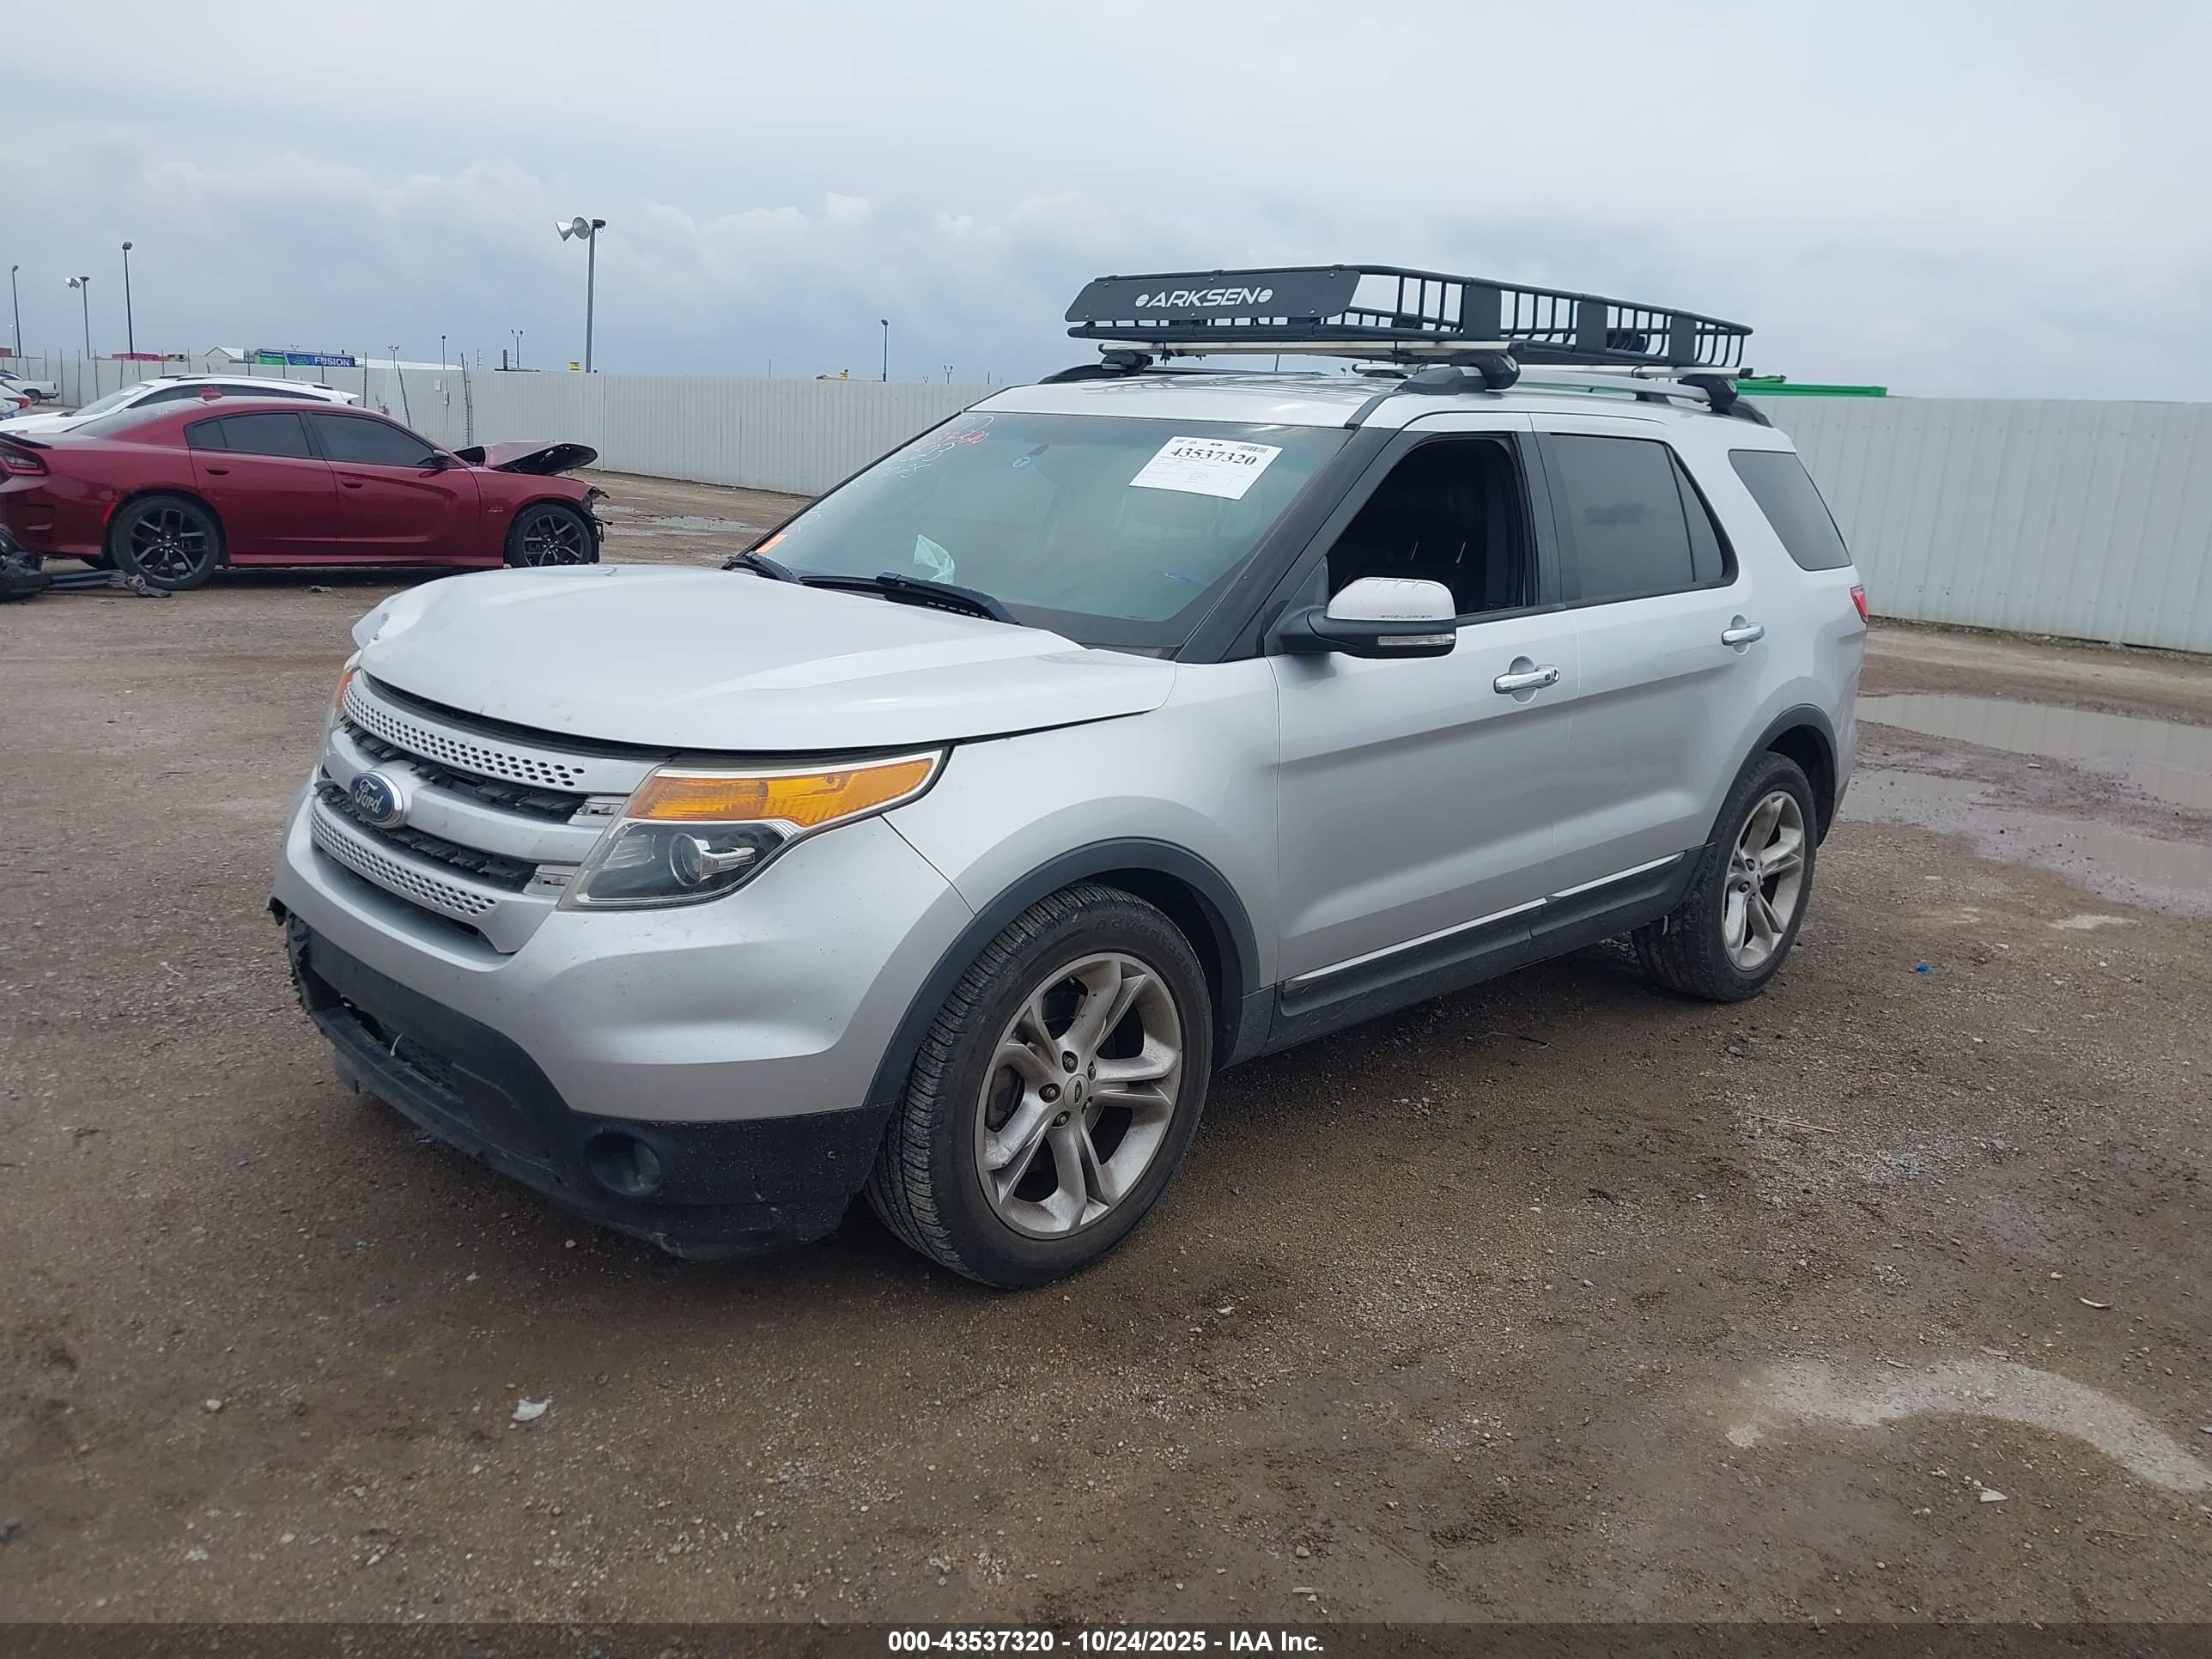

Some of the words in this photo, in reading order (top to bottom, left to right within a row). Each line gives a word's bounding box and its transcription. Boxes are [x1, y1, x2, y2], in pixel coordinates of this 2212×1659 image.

[1146, 287, 1261, 308] ARKSEN
[314, 356, 349, 366] FUSION
[1170, 447, 1257, 465] 43537320
[355, 778, 384, 814] Ford
